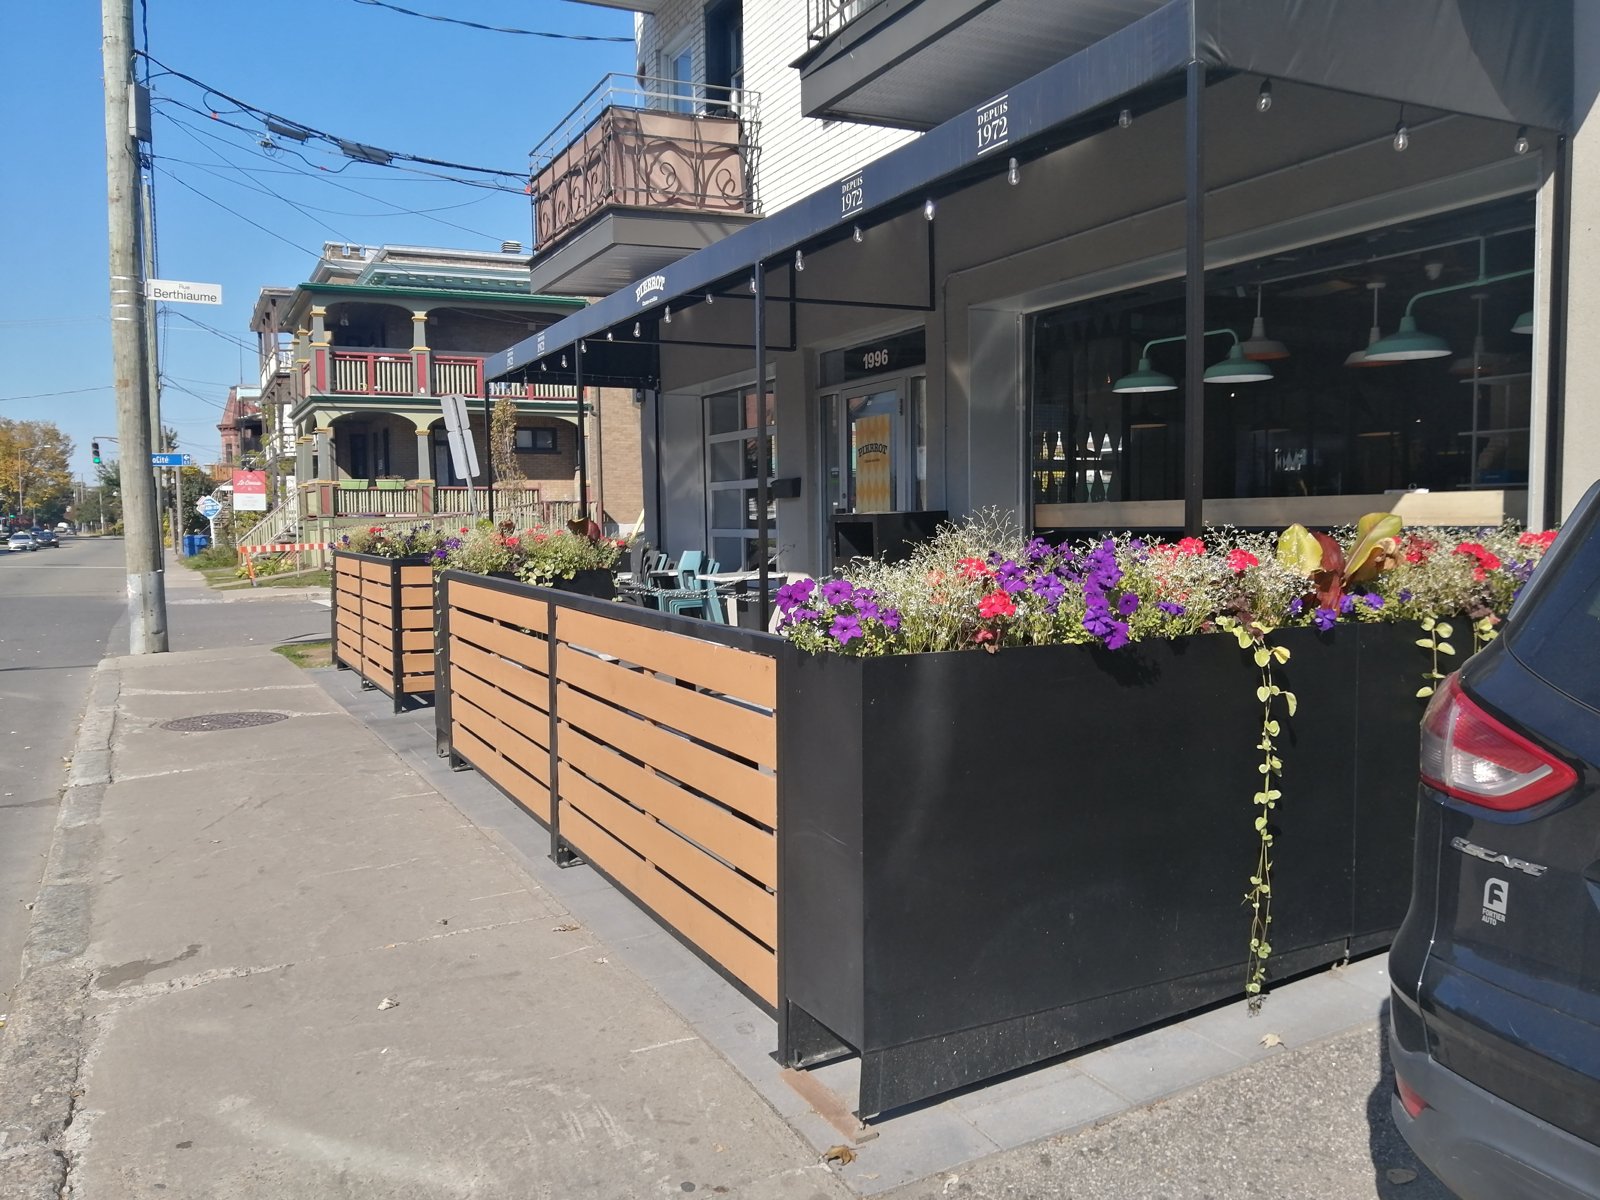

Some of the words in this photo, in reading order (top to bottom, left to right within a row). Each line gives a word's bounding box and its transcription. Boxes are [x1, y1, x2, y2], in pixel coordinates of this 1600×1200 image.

[978, 101, 1008, 126] DEPUIS
[977, 116, 1008, 148] 1972
[842, 176, 863, 194] DEPUIS
[842, 188, 863, 212] 1972
[153, 287, 217, 302] Berthiaume
[635, 275, 666, 303] PIERROT
[863, 349, 889, 369] 1996
[152, 455, 169, 464] oCité
[858, 443, 888, 457] PIERROT
[1450, 836, 1548, 877] ESCAPE
[1481, 915, 1497, 926] AUTO
[1482, 907, 1506, 923] FORTIER
